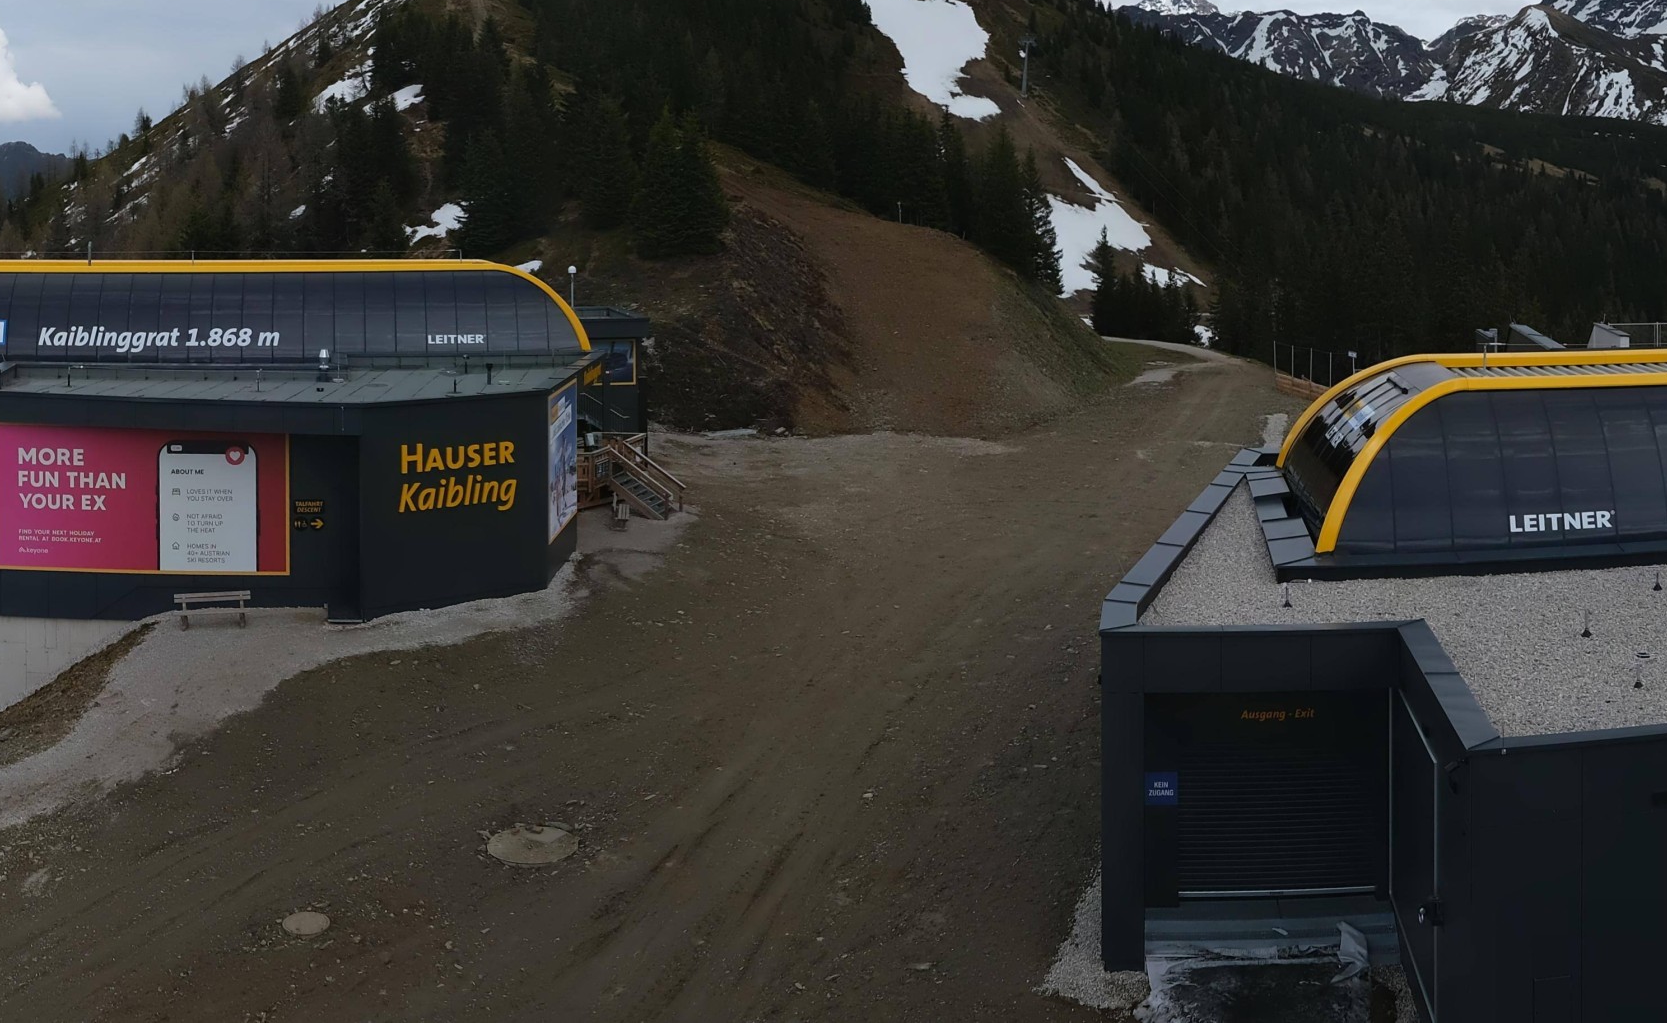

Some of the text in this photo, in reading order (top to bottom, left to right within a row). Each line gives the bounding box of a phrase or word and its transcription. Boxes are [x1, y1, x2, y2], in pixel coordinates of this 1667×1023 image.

[38, 326, 280, 353] Kaiblinggrat 1.868 m
[427, 334, 484, 344] LEITNER
[18, 447, 85, 466] MORE
[400, 441, 516, 474] HAUSER
[18, 470, 126, 489] FUN THAN
[19, 493, 106, 511] YOUR EX
[398, 475, 517, 513] Kaibling
[1509, 510, 1612, 532] LEITNER
[1240, 709, 1286, 721] Ausgang
[1295, 708, 1315, 718] Exit
